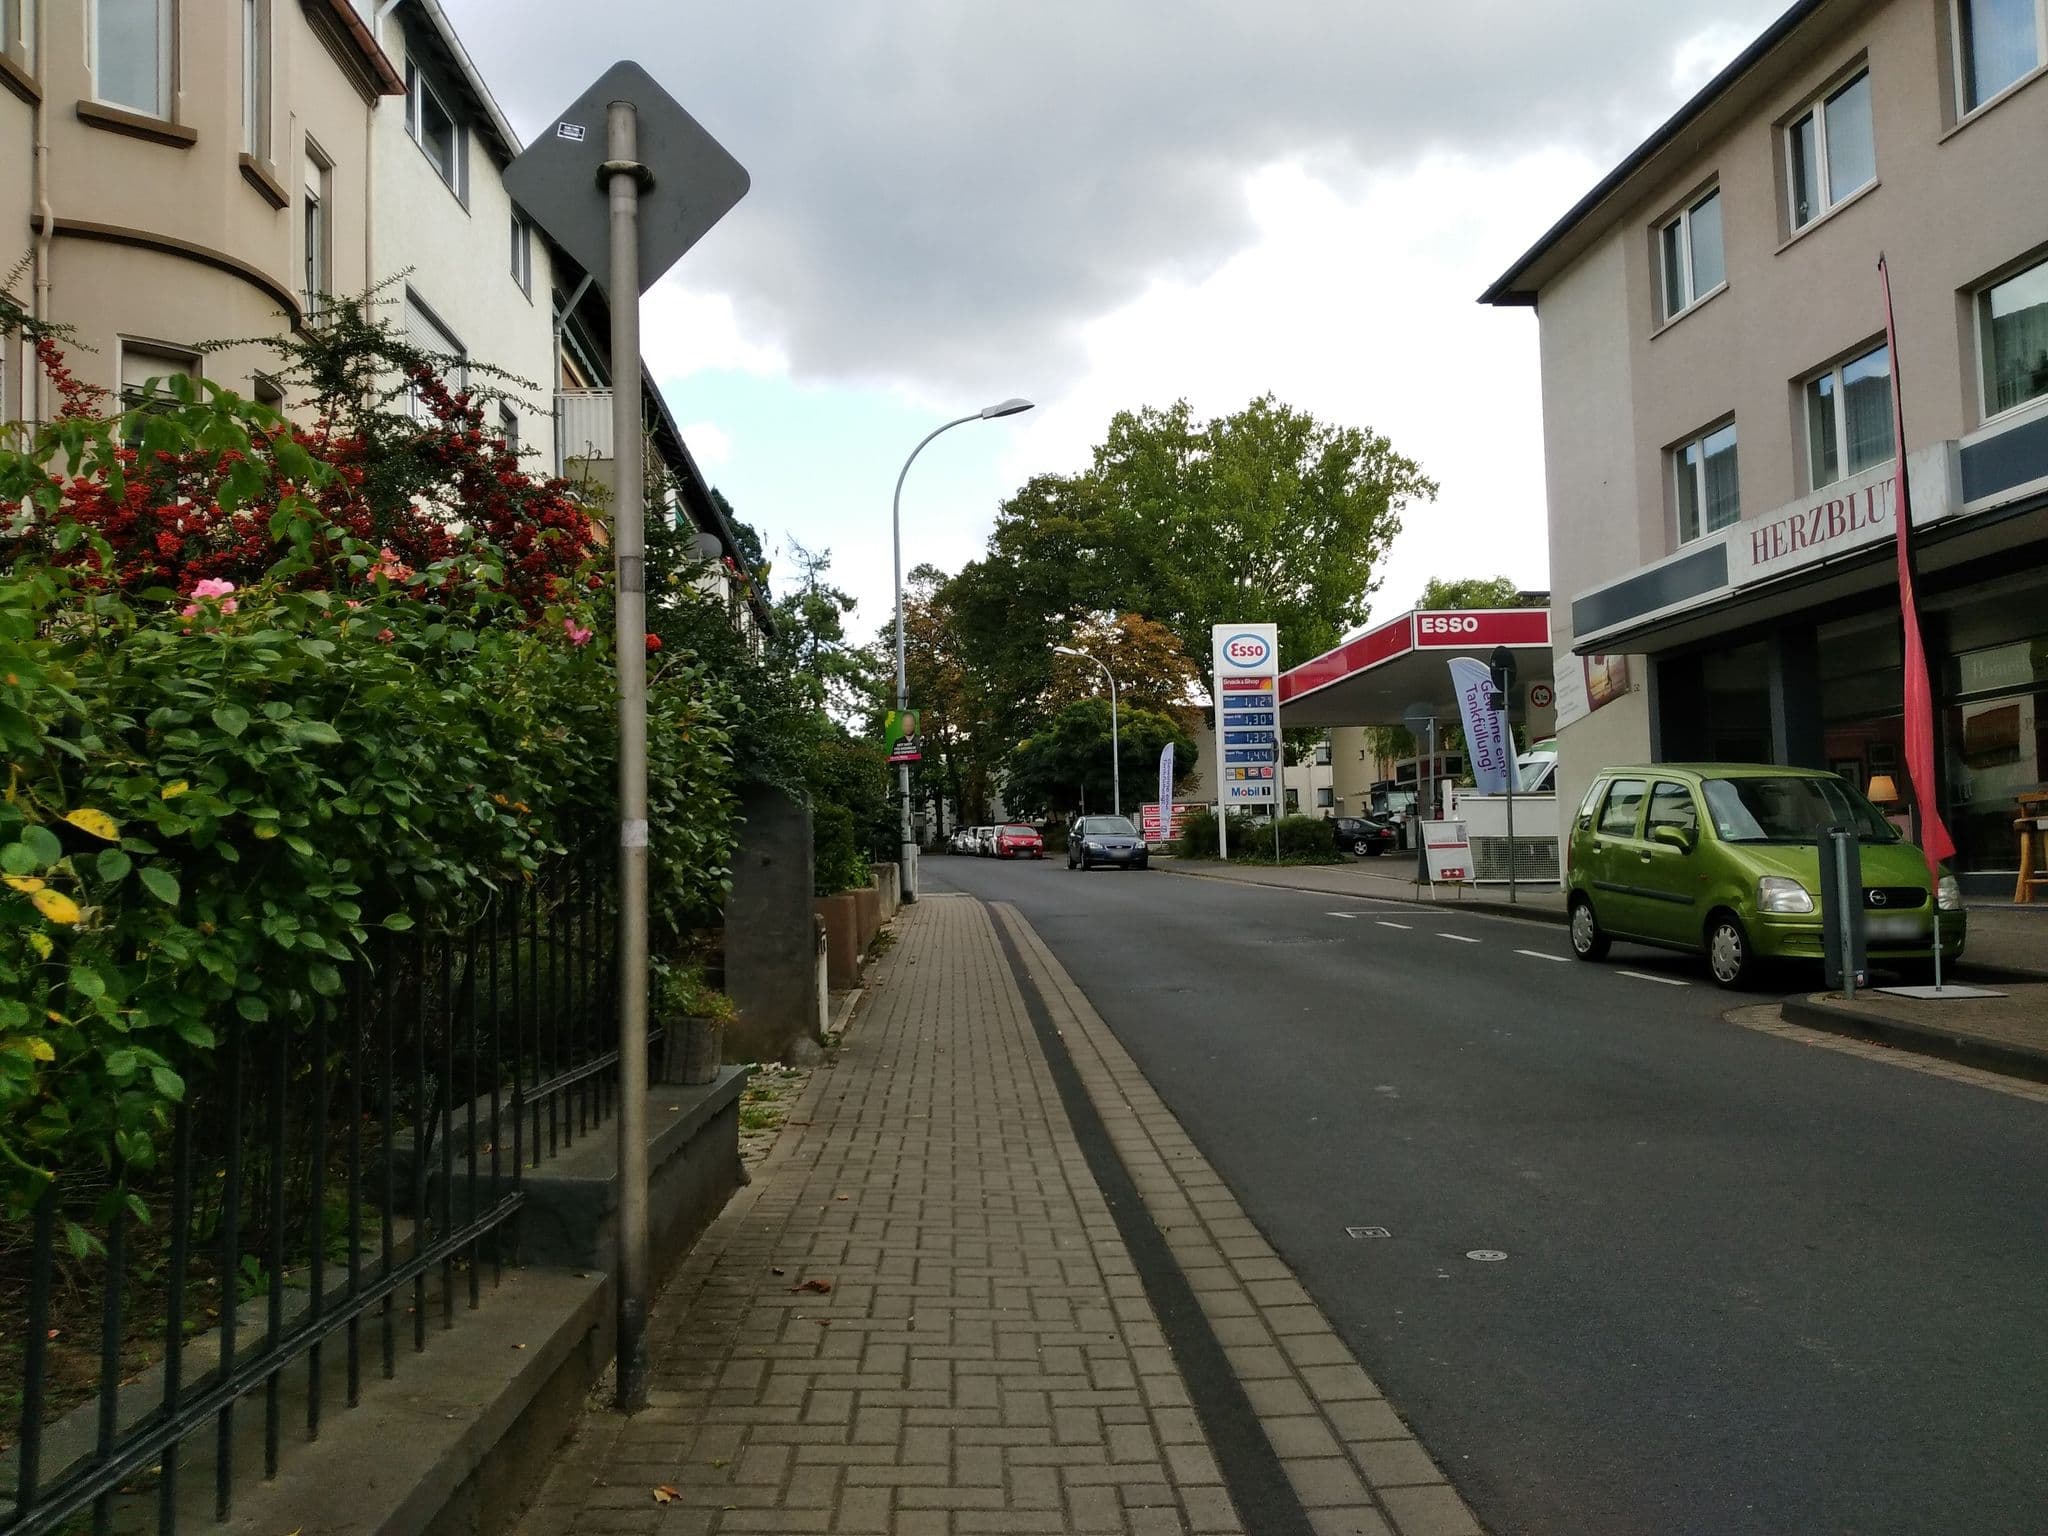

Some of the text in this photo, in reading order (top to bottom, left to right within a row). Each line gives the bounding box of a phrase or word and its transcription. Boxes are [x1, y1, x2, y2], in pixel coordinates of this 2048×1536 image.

[1421, 616, 1479, 634] ESSO
[1230, 643, 1264, 657] Esso
[1465, 683, 1497, 772] Tankfüllung!
[1480, 680, 1508, 778] Gewinne eine
[1231, 786, 1260, 797] Mobil
